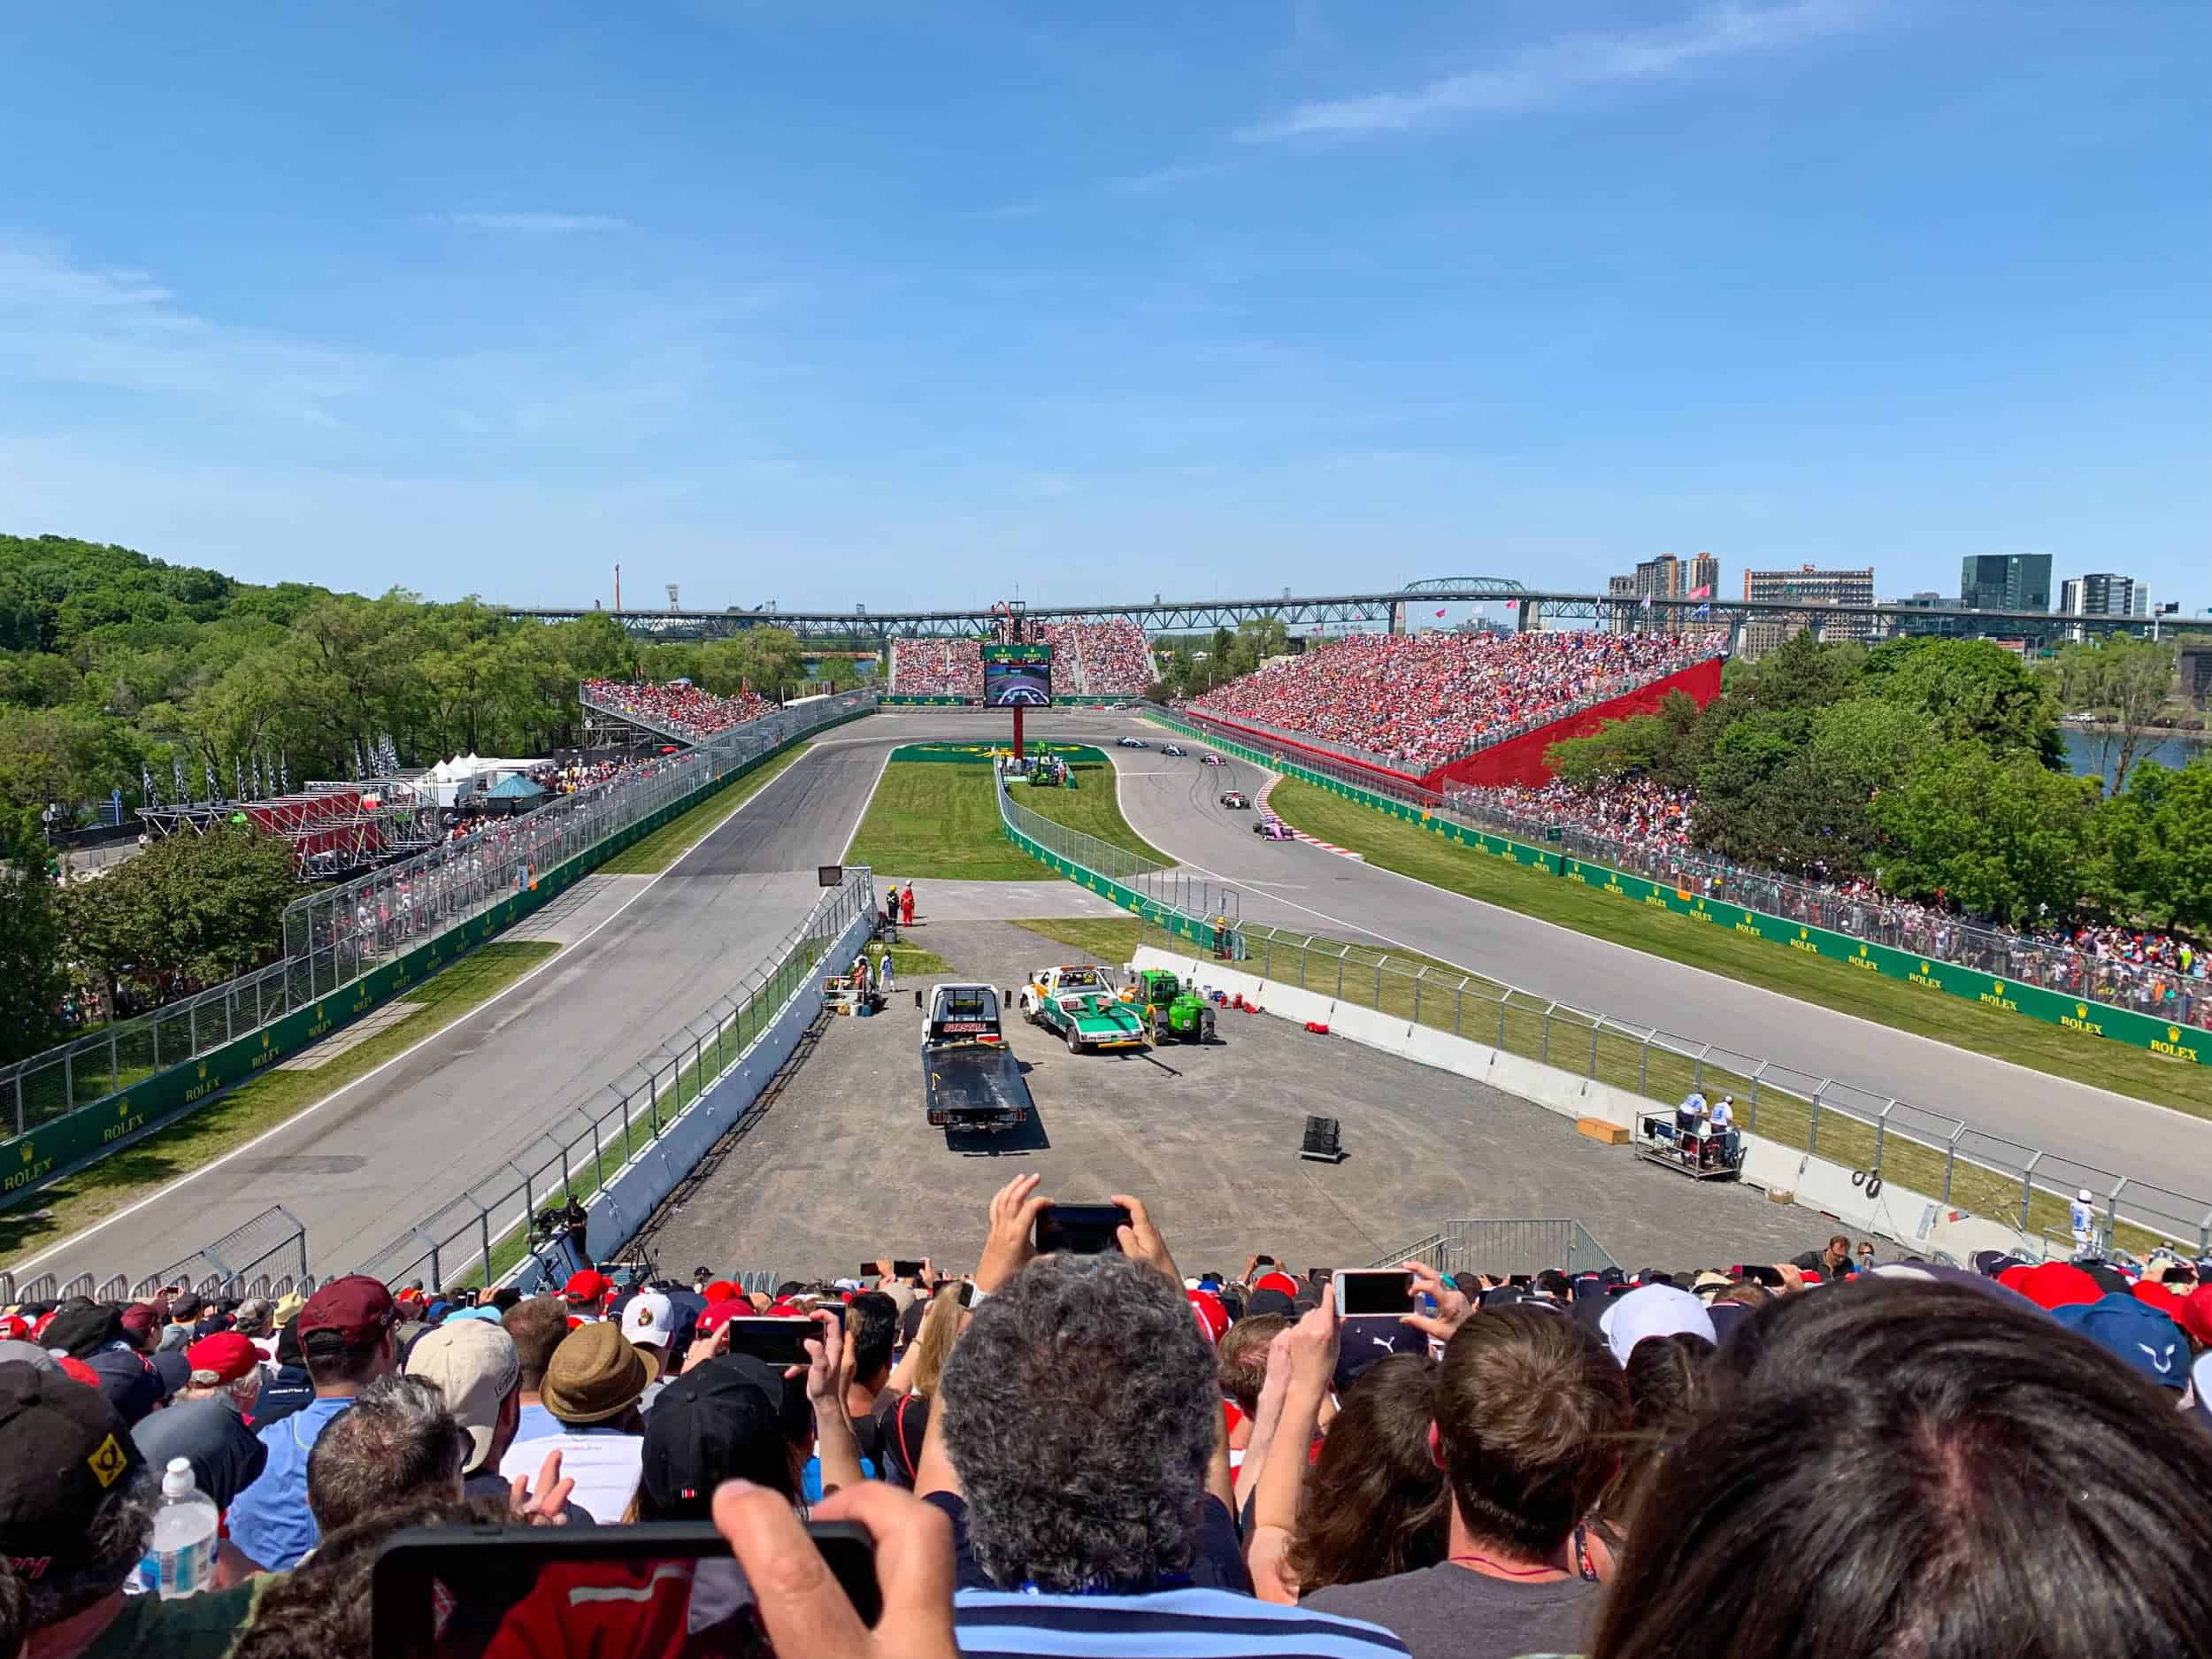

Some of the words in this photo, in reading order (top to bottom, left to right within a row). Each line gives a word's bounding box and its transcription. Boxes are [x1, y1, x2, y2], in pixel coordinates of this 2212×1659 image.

[1645, 895, 1667, 908] ROLEX
[1689, 909, 1713, 922] ROLEX
[1735, 922, 1761, 936] ROLEX
[1790, 938, 1818, 953] ROLEX
[1848, 955, 1879, 972] ROLEX
[1909, 972, 1942, 990] ROLEX
[1980, 992, 2018, 1011] ROLEX
[2060, 1015, 2103, 1035] ROLEX
[251, 1045, 282, 1069] ROLEX
[2150, 1039, 2198, 1062] ROLEX
[185, 1075, 221, 1102] ROLEX
[104, 1112, 145, 1141] ROLEX
[4, 1156, 54, 1190] ROLEX
